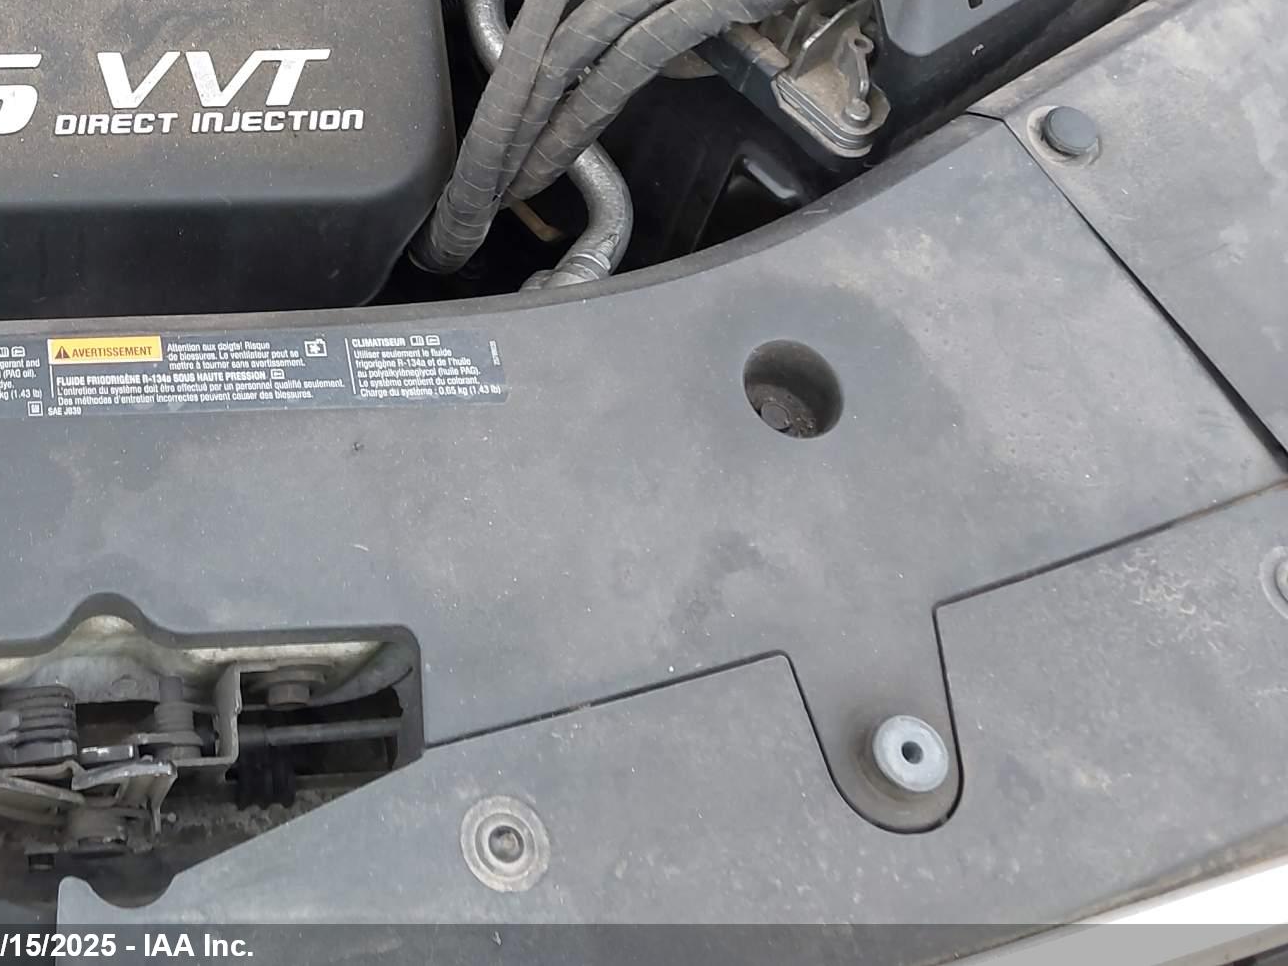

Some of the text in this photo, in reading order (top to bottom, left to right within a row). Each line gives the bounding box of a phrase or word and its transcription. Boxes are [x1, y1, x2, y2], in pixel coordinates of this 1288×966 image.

[97, 49, 331, 109] VVT
[55, 108, 364, 136] DIRECT INJECTION
[167, 343, 200, 352] Attention
[245, 341, 270, 350] Risque
[352, 338, 406, 347] CLIMATISEUR
[72, 346, 152, 358] AVERTISSEMENT
[180, 352, 218, 360] blessures.
[220, 351, 228, 359] Le
[230, 350, 269, 359] ventilateur
[272, 350, 288, 359] peut
[354, 348, 451, 358] Utiliser seulement le fluide
[169, 361, 193, 370] mettre
[203, 360, 229, 368] tourner
[251, 358, 305, 366] avertissement.
[398, 359, 426, 367] R-134a
[427, 359, 435, 367] et
[437, 358, 447, 366] de
[4, 369, 20, 379] (PAG
[56, 376, 85, 386] FLUIDE
[173, 373, 194, 382] SOUS
[197, 372, 223, 382] HAUTE
[226, 370, 266, 380] PRESSION
[358, 370, 367, 378] au
[0, 380, 14, 390] dye.
[100, 386, 108, 395] du
[111, 385, 142, 396] système
[144, 384, 158, 393] doit
[160, 383, 175, 393] être
[209, 382, 222, 392] par
[224, 382, 233, 390] un
[236, 381, 272, 392] personnel
[274, 380, 302, 390] qualifié
[304, 378, 345, 388] seulement.
[371, 378, 402, 389] système
[404, 377, 434, 386] contient
[447, 377, 480, 385] colorant.
[0, 390, 8, 401] kg
[360, 389, 388, 398] Charge
[401, 386, 433, 398] système
[458, 385, 468, 395] kg
[58, 396, 72, 405] Des
[74, 394, 112, 404] méthodes
[156, 392, 198, 402] incorrectes
[200, 392, 230, 402] peuvent
[232, 391, 258, 400] causer
[260, 390, 273, 398] des
[275, 390, 313, 399] blessures.
[48, 407, 62, 415] SAE
